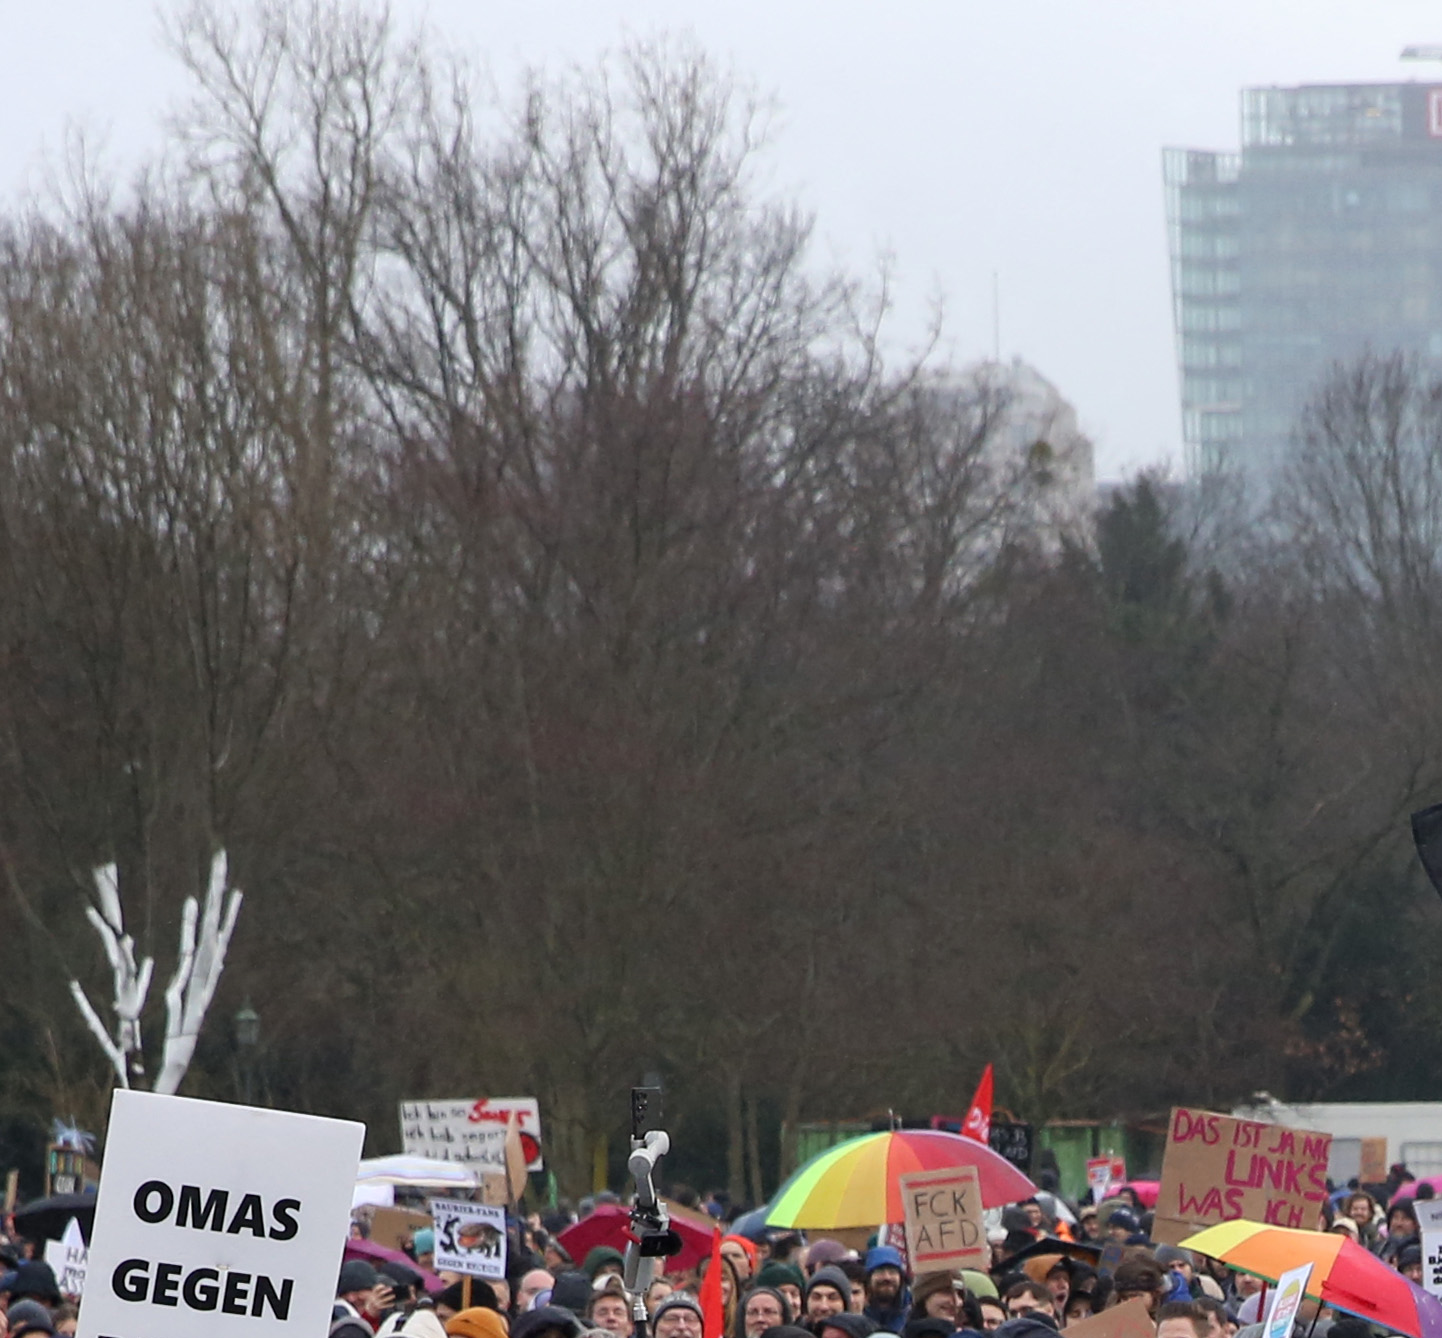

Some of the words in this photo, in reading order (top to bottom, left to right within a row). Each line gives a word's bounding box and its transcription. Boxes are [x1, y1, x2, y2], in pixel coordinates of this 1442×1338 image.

[1173, 1109, 1220, 1145] DAS
[1233, 1121, 1268, 1148] IST
[1269, 1131, 1294, 1154] JA
[1225, 1150, 1329, 1203] LINKS
[133, 1180, 301, 1241] OMAS
[914, 1189, 967, 1219] FCK
[1179, 1183, 1244, 1221] WAS
[1264, 1200, 1304, 1228] ICH
[915, 1220, 979, 1250] AFD
[111, 1258, 294, 1321] GEGEN
